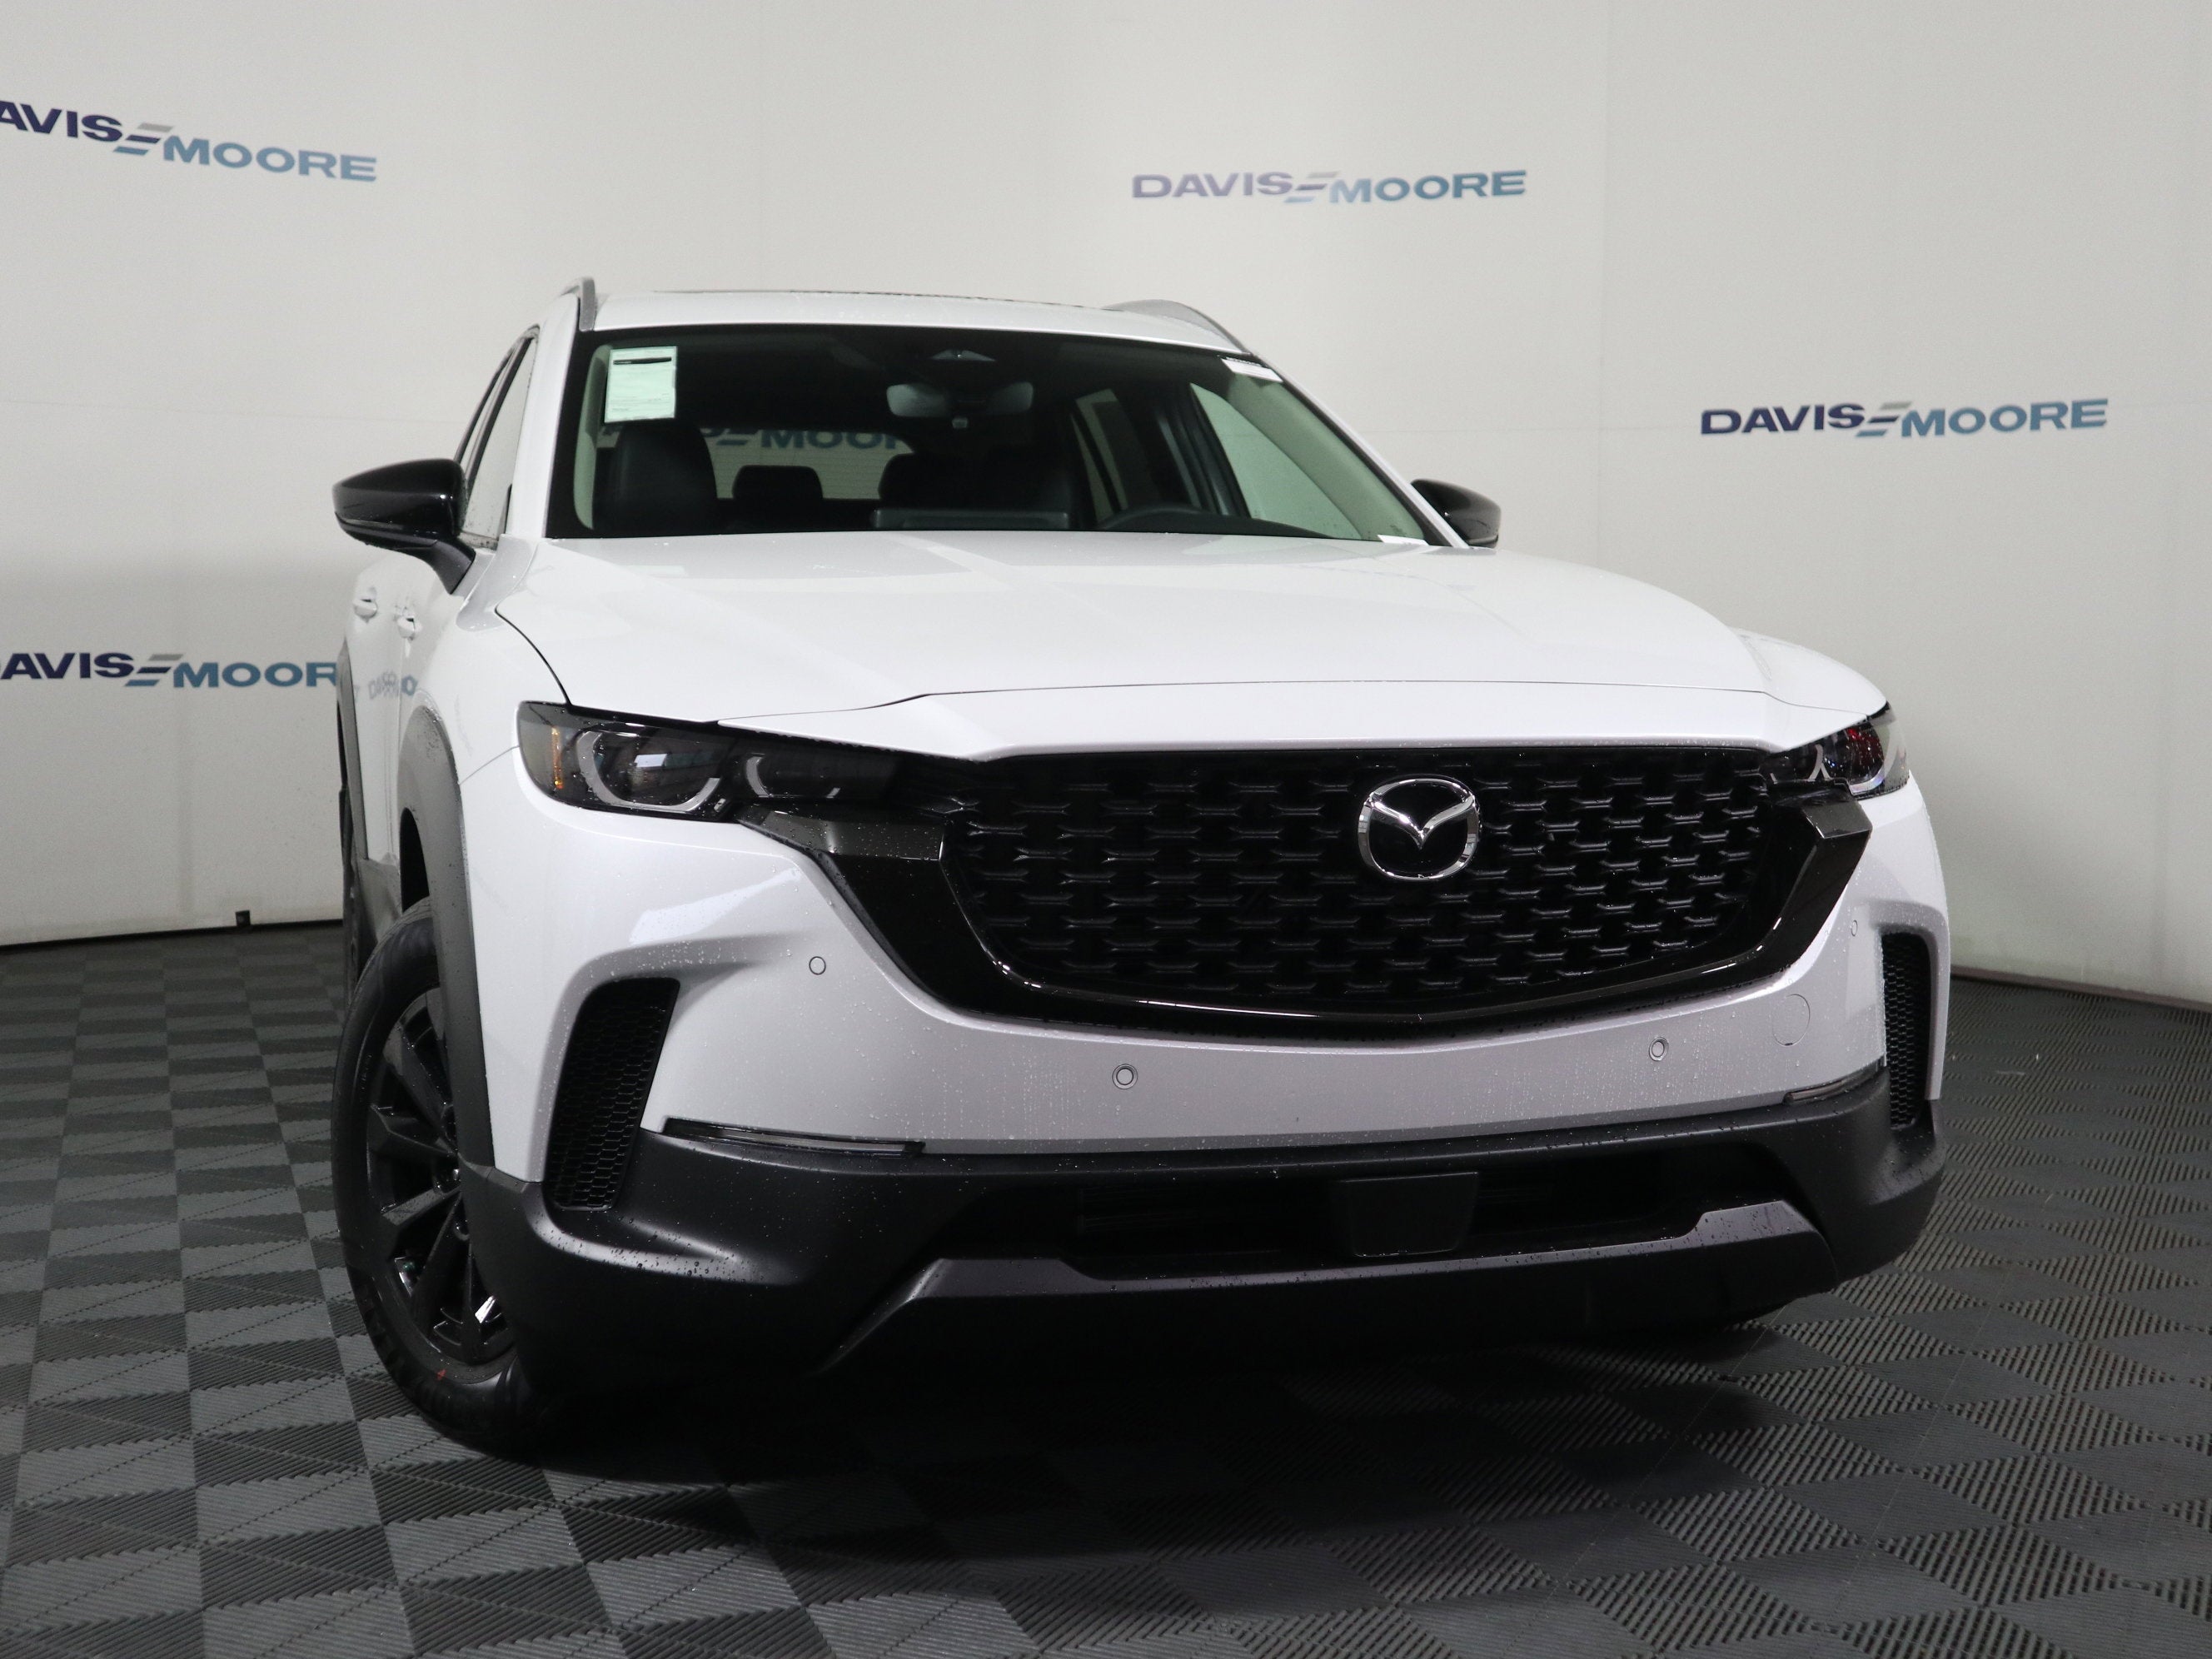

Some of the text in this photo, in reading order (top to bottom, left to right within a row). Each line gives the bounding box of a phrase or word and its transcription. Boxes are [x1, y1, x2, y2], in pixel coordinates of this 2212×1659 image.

[0, 100, 376, 182] AVIS MOORE
[1132, 170, 1526, 202] DAVIS MOORE
[1701, 398, 2108, 437] DAVIS MOORE
[761, 429, 896, 450] MOO
[0, 652, 133, 680] AVIS
[172, 661, 336, 689] MOOR
